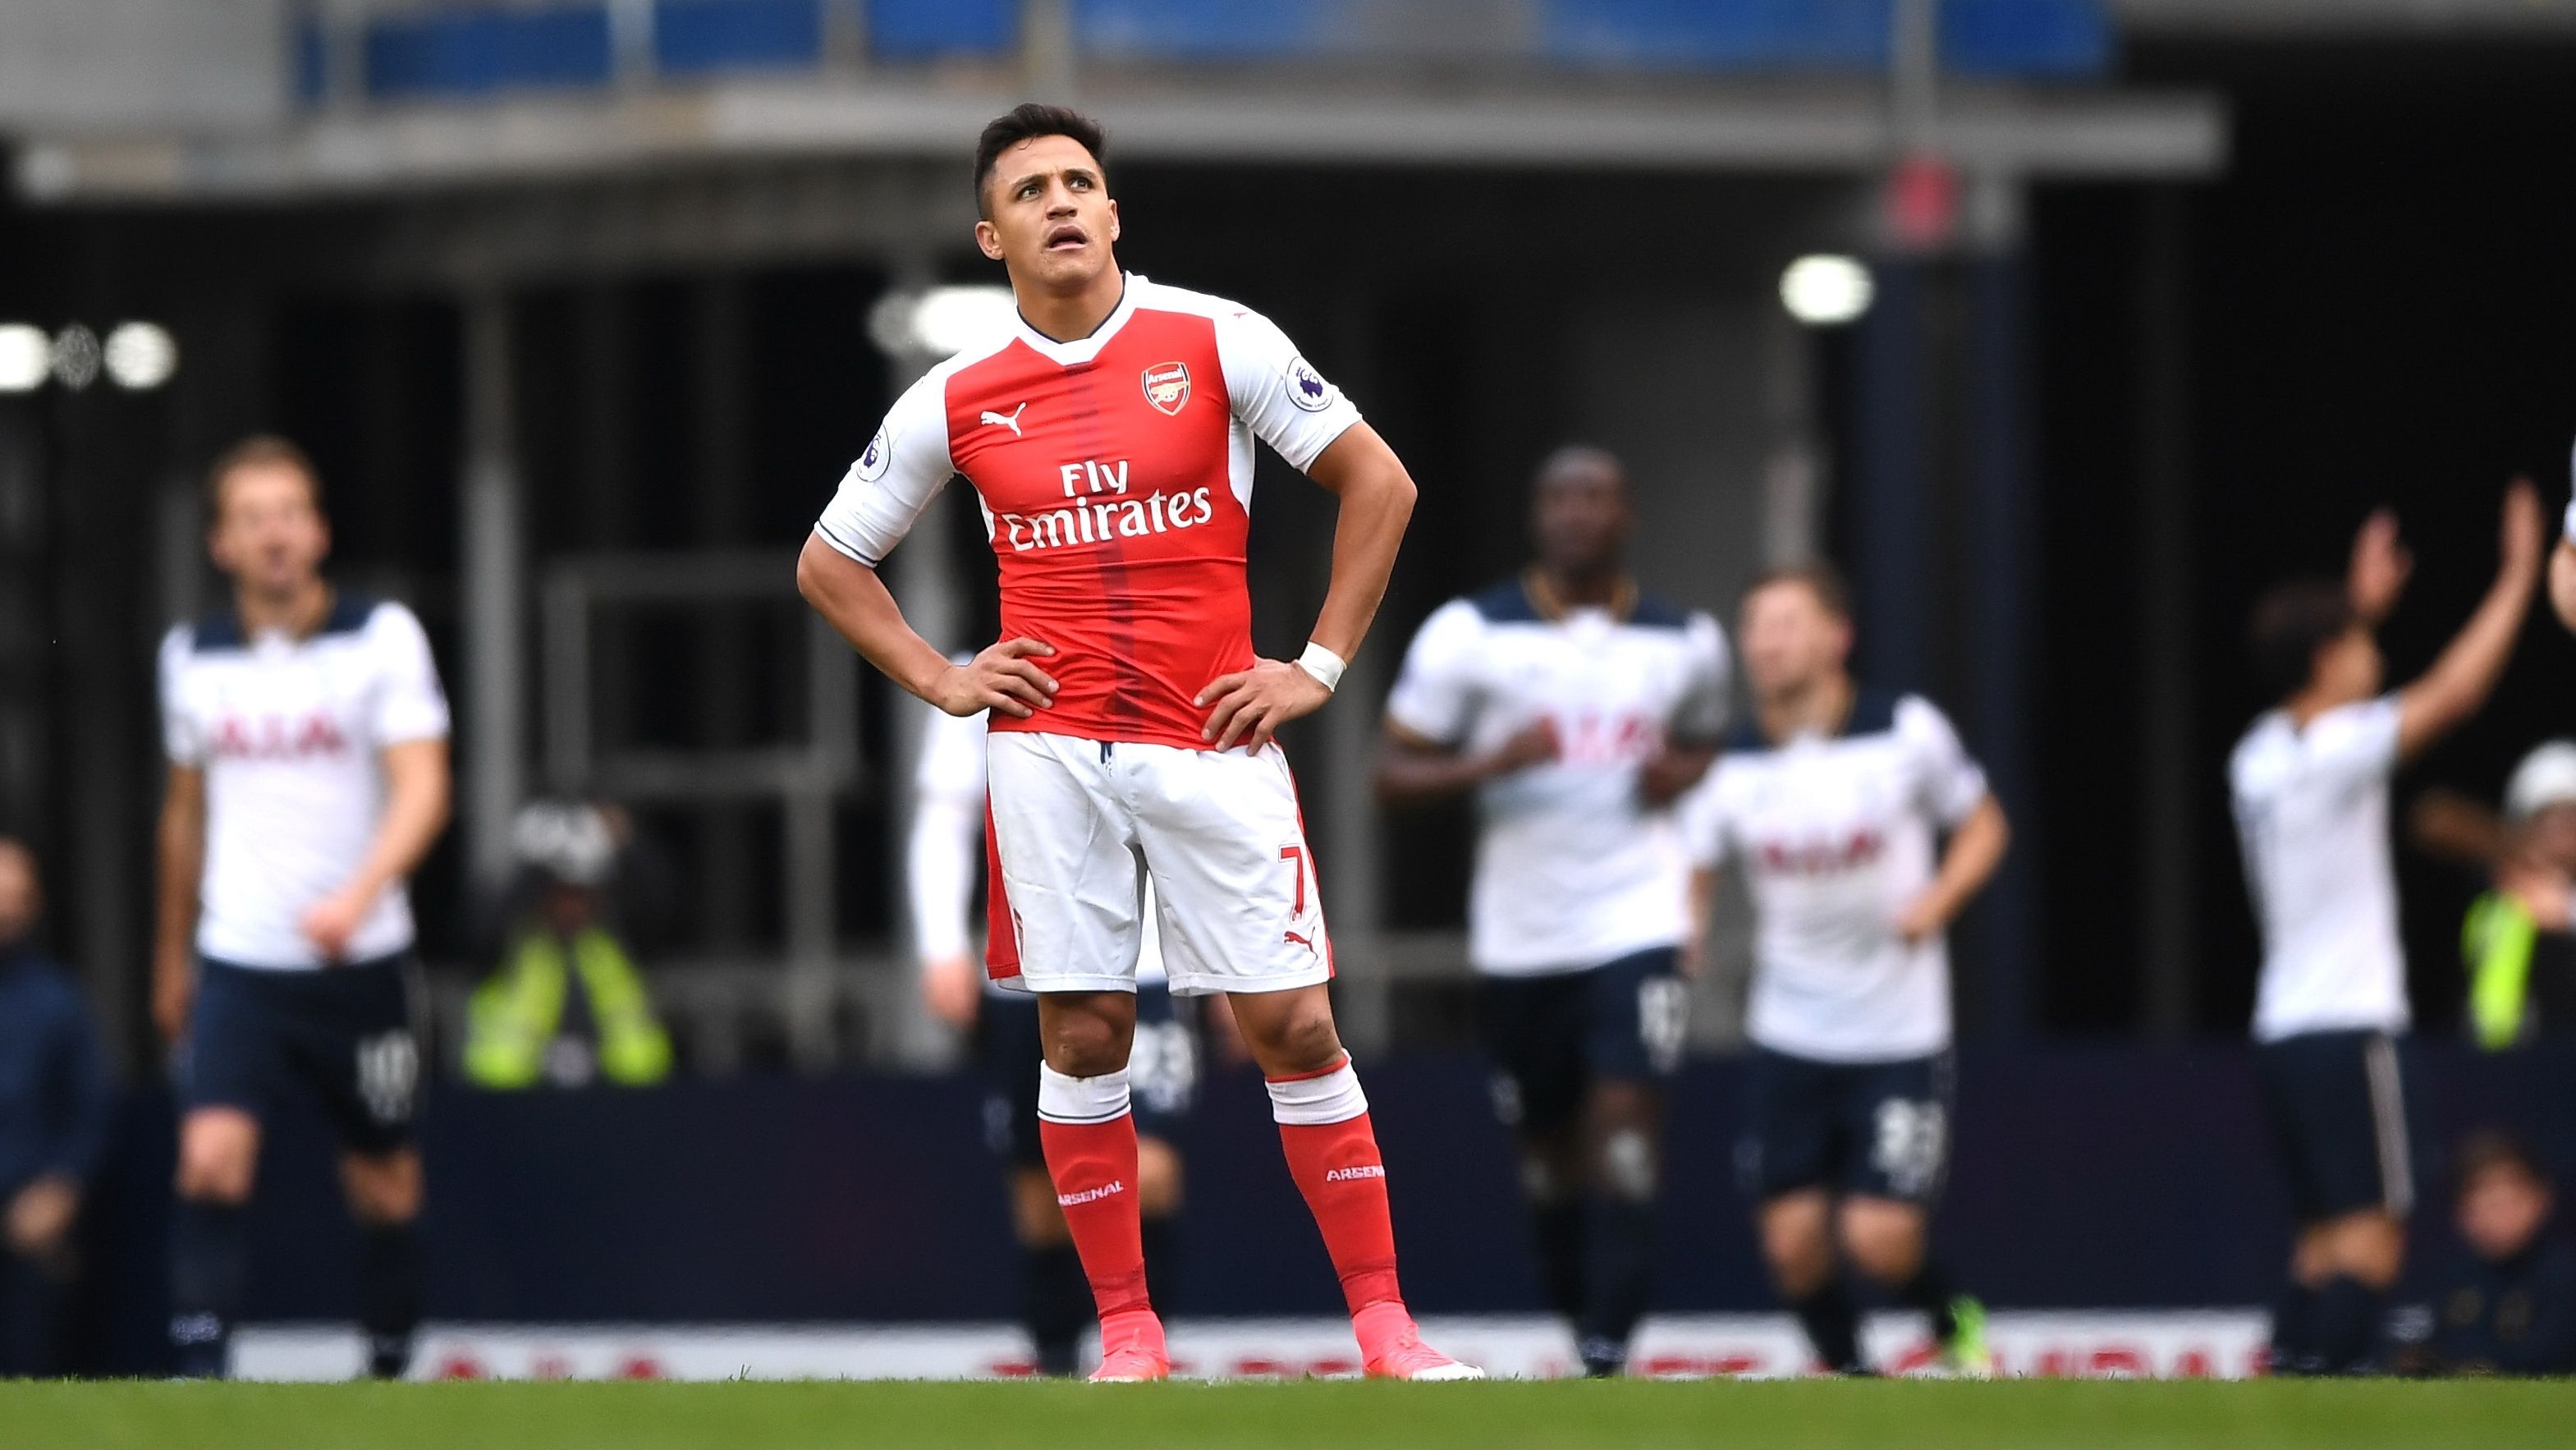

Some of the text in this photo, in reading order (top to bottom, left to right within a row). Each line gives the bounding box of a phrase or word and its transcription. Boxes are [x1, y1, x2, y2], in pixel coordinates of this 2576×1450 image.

[1148, 369, 1183, 384] Arsenal
[1060, 460, 1128, 498] Fly
[1002, 487, 1212, 552] Emirates
[1278, 844, 1305, 924] 7
